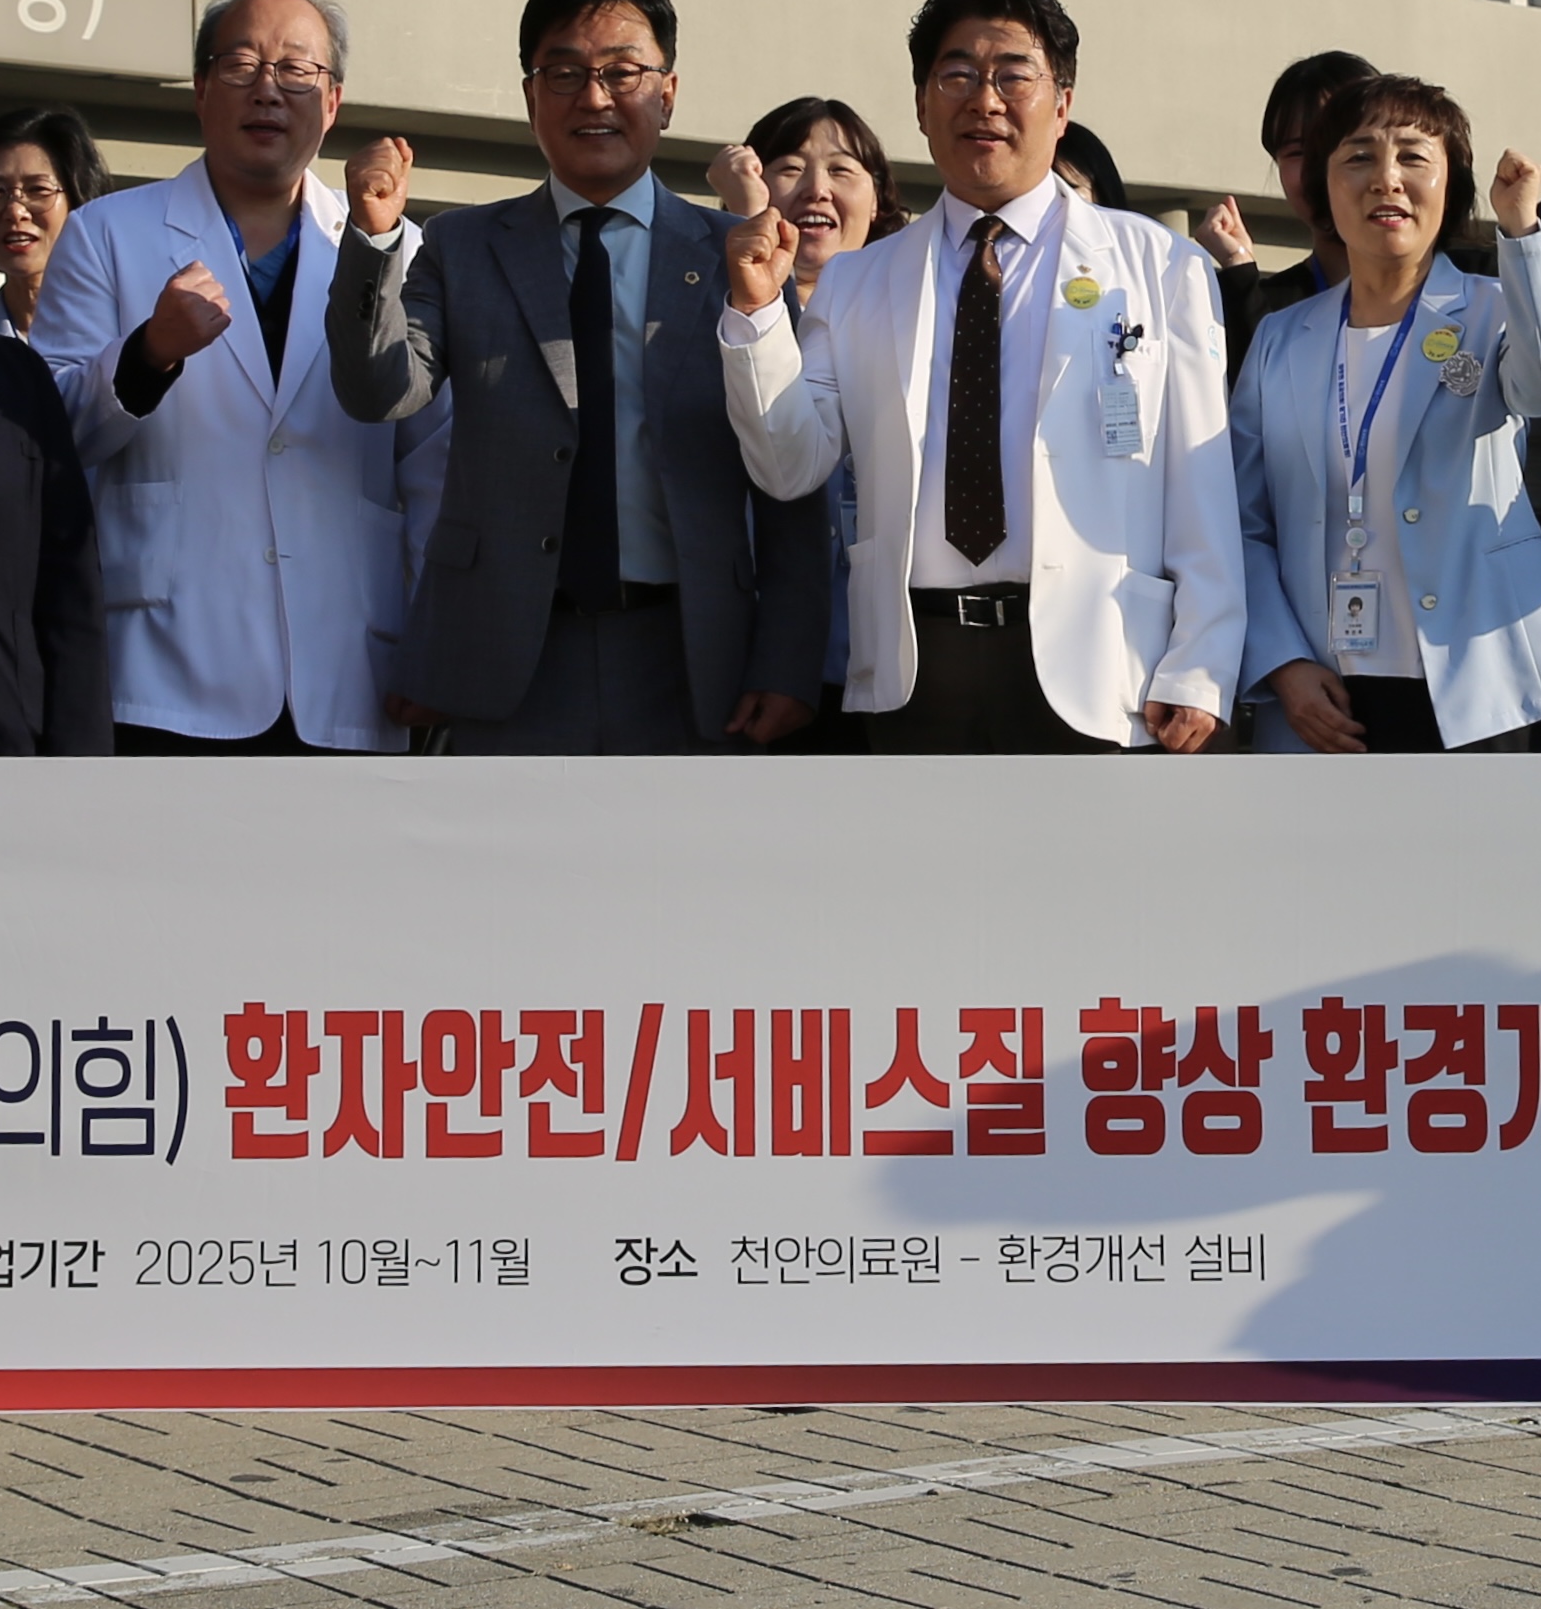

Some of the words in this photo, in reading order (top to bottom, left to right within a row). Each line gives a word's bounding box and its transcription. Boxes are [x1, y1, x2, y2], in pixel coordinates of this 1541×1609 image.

[224, 1001, 1047, 1162] 환자안전/서비스질
[1080, 997, 1274, 1155] 향상
[135, 1239, 298, 1288] 2025년
[318, 1238, 531, 1287] 10월~11월
[614, 1236, 699, 1286] 장소
[730, 1235, 942, 1285] 천안의료원
[997, 1234, 1166, 1284] 환경개선
[1184, 1233, 1267, 1282] 설비
